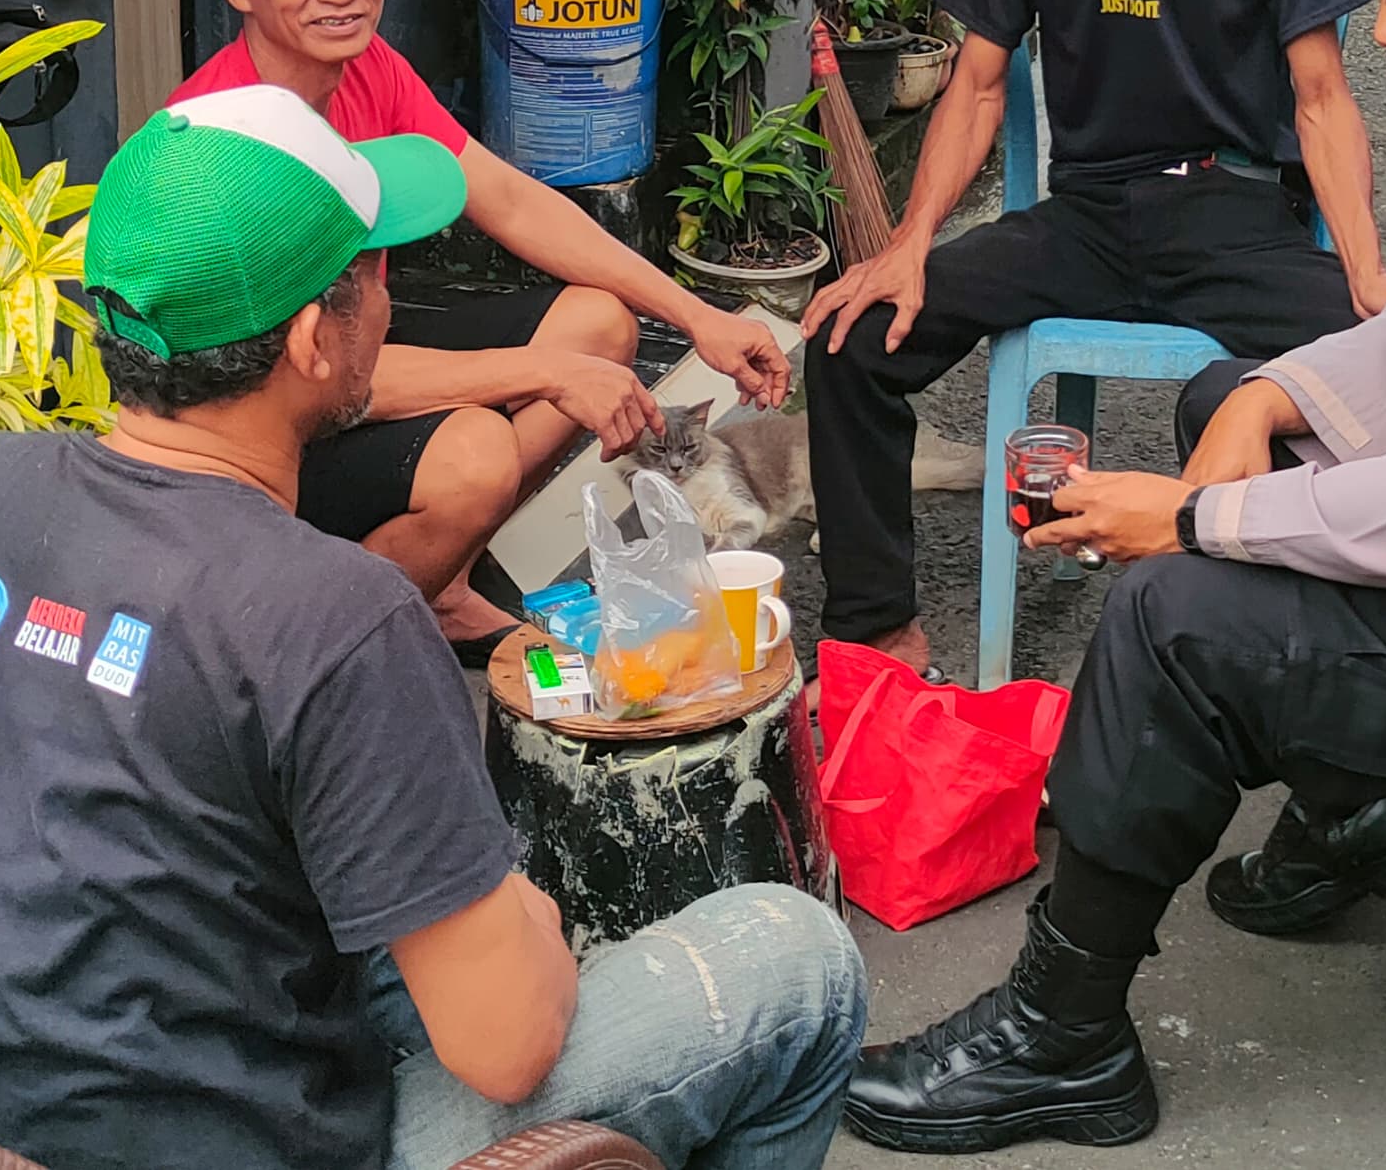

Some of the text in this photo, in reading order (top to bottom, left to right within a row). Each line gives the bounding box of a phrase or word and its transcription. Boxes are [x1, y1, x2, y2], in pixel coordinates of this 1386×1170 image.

[26, 596, 87, 638] MERDEKA
[14, 619, 81, 665] BELAJAR
[113, 619, 148, 646] MIT
[102, 640, 140, 668] RAS
[93, 664, 131, 688] DUDI
